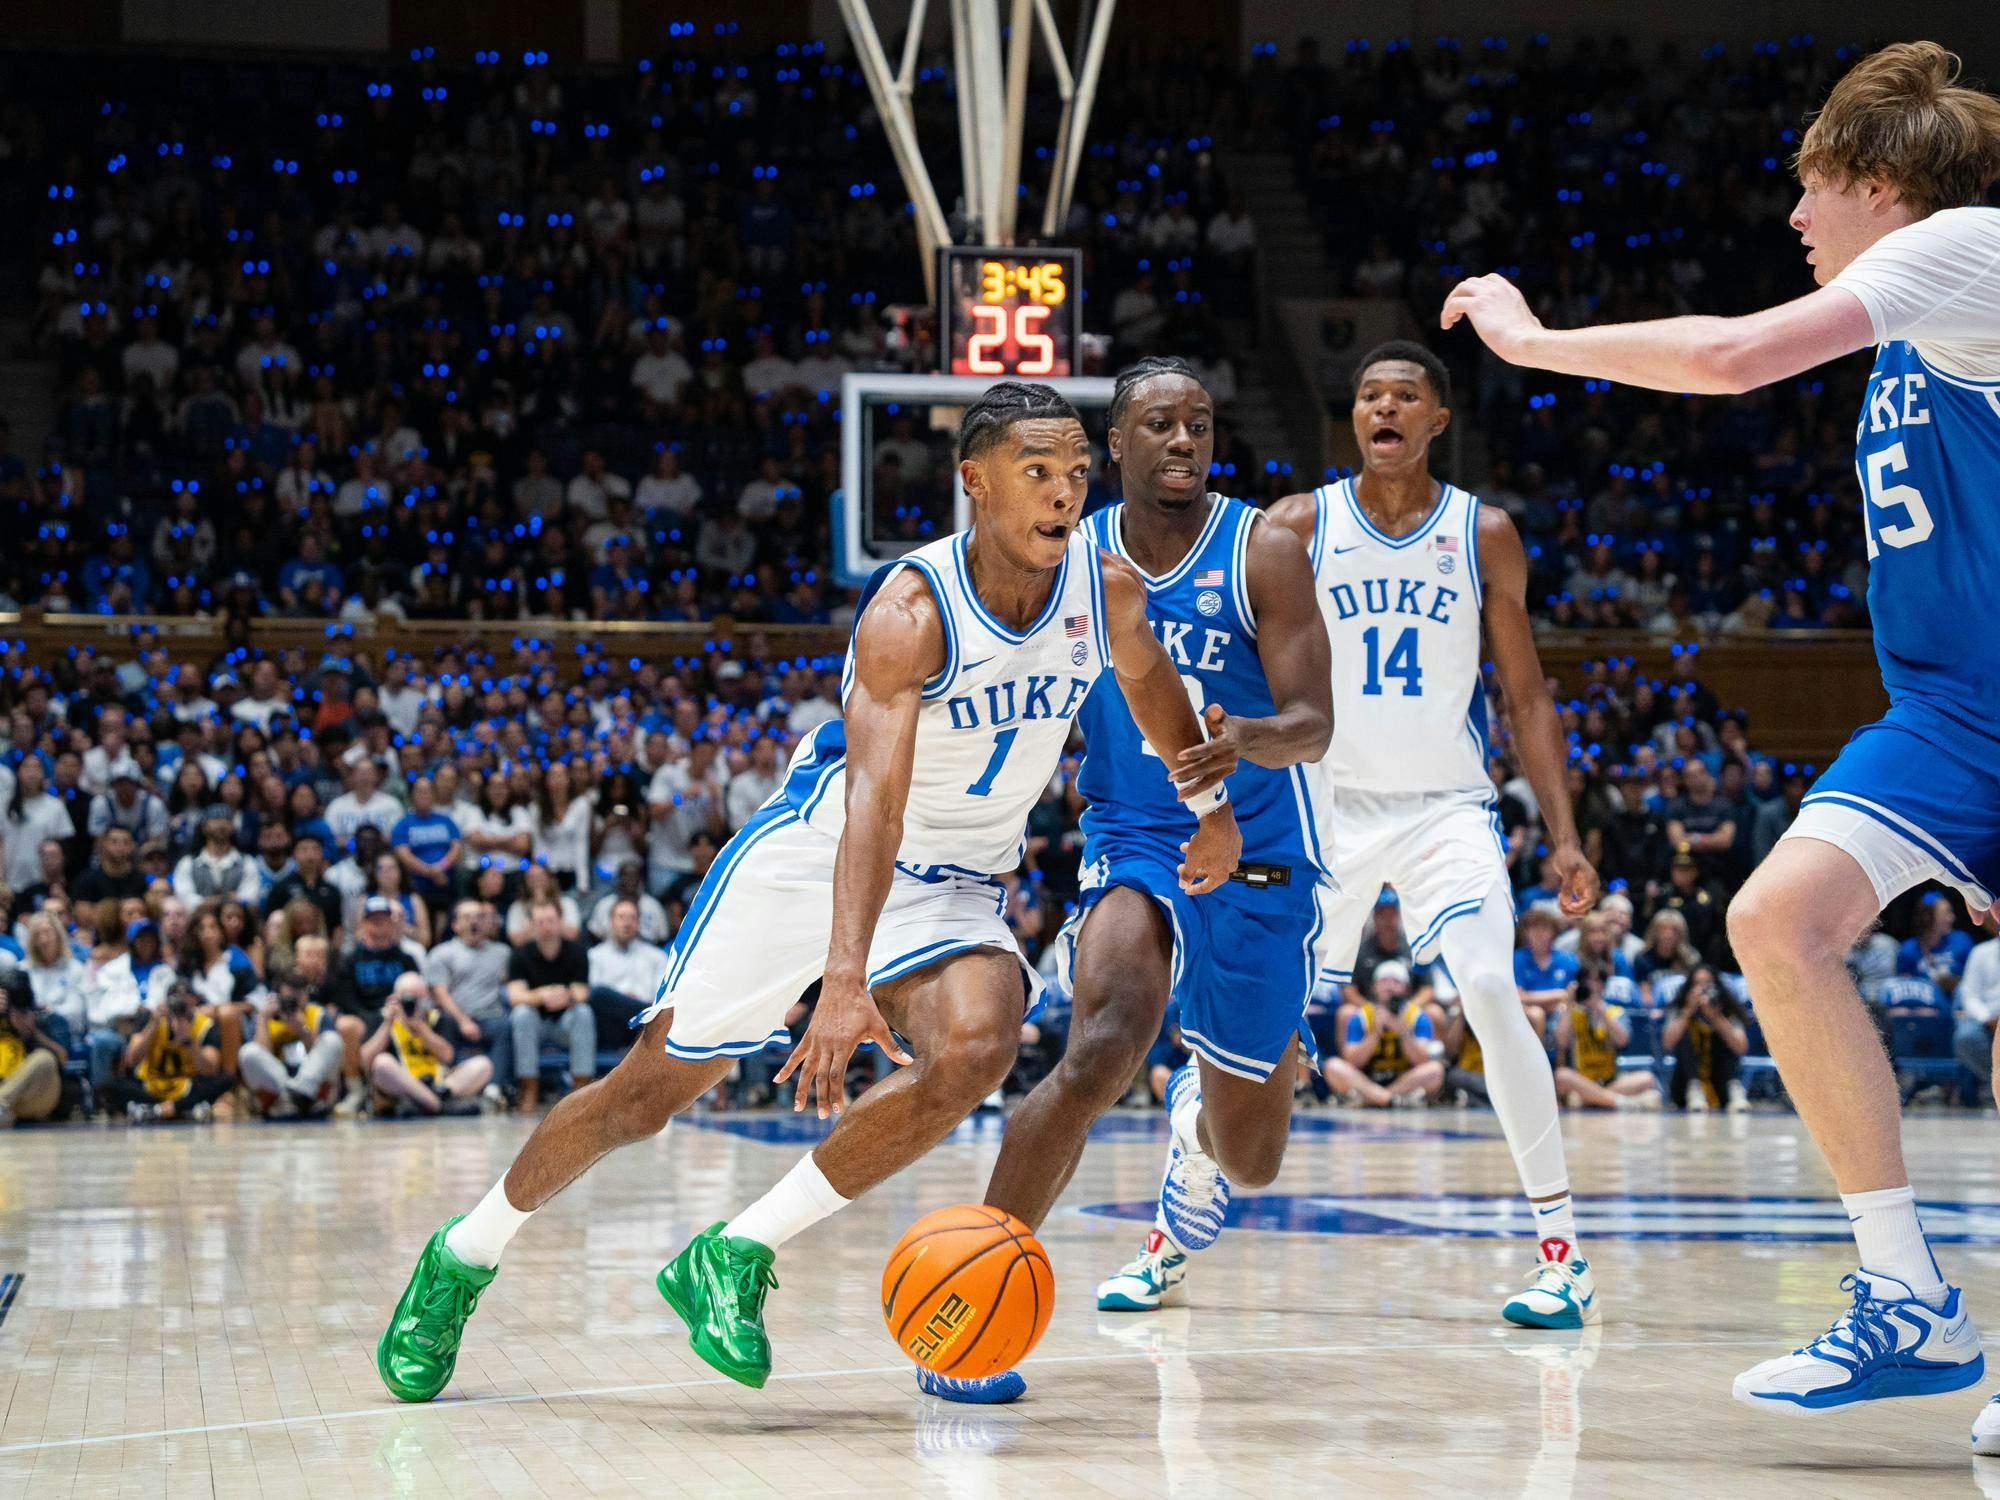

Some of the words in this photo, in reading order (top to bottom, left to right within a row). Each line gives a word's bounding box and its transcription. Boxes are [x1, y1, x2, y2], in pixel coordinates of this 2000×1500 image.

[982, 261, 1066, 305] 3:45
[968, 304, 1055, 375] 25
[1857, 373, 1930, 444] KE
[1329, 578, 1458, 624] DUKE
[1148, 620, 1231, 671] KE
[1362, 626, 1422, 696] 14
[947, 675, 1089, 729] DUKE
[966, 727, 1019, 797] 1
[1270, 870, 1281, 880] 48
[908, 1291, 971, 1361] ELITE
